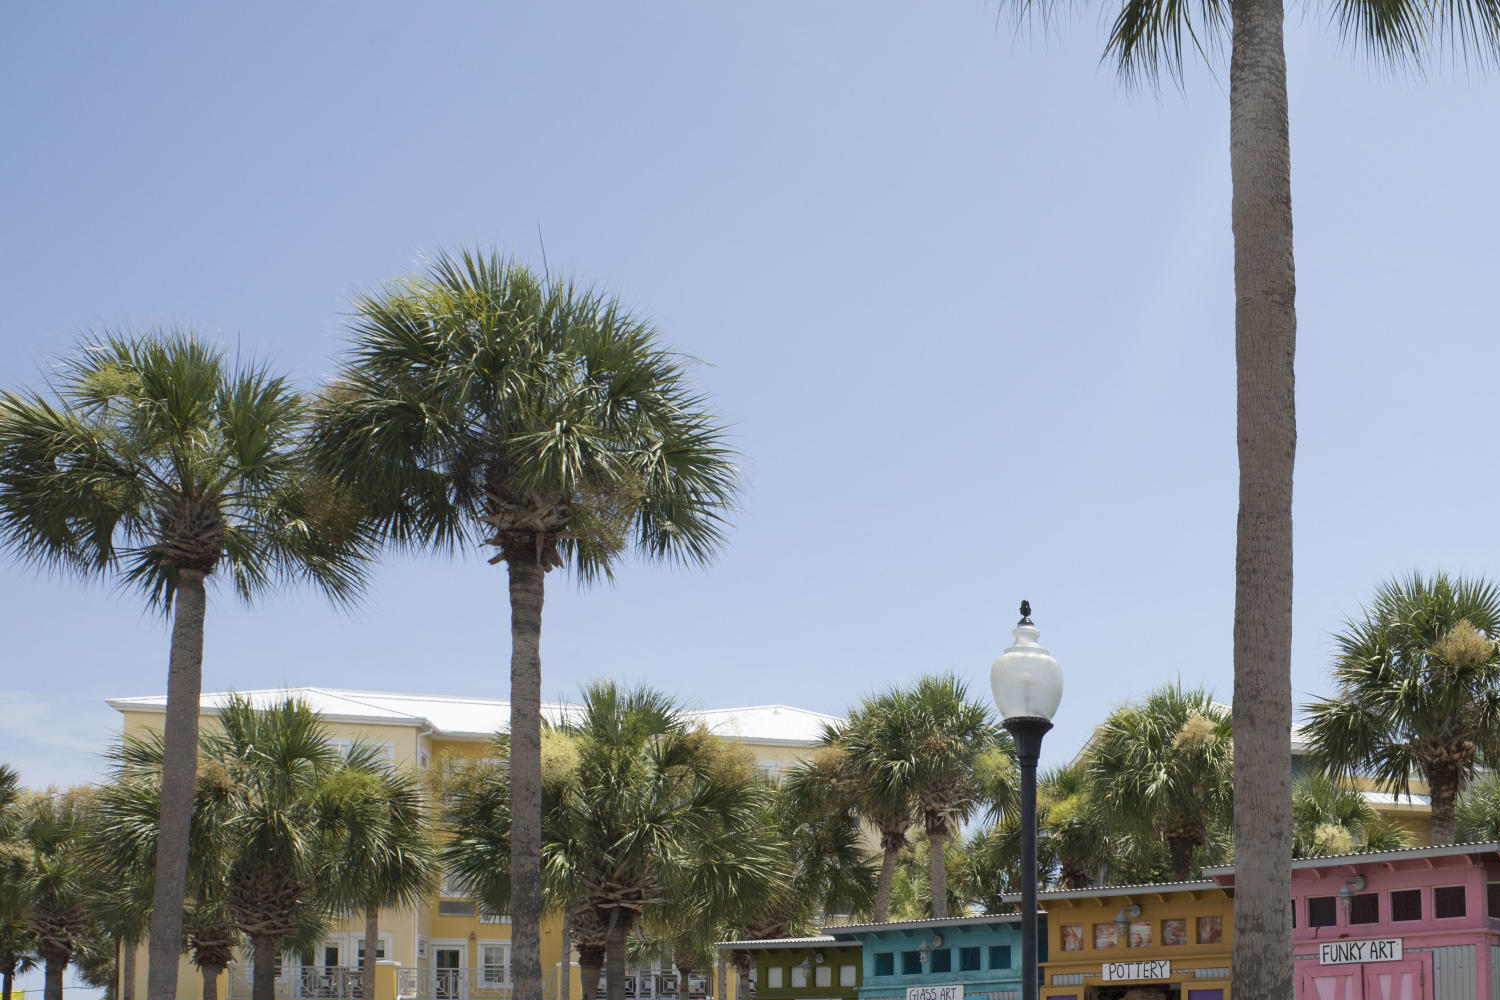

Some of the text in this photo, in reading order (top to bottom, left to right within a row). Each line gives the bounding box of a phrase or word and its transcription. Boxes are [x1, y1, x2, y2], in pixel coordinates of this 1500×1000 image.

[1322, 941, 1396, 962] FUNKY ART
[1108, 961, 1168, 980] POTTERY
[940, 987, 957, 1000] ART
